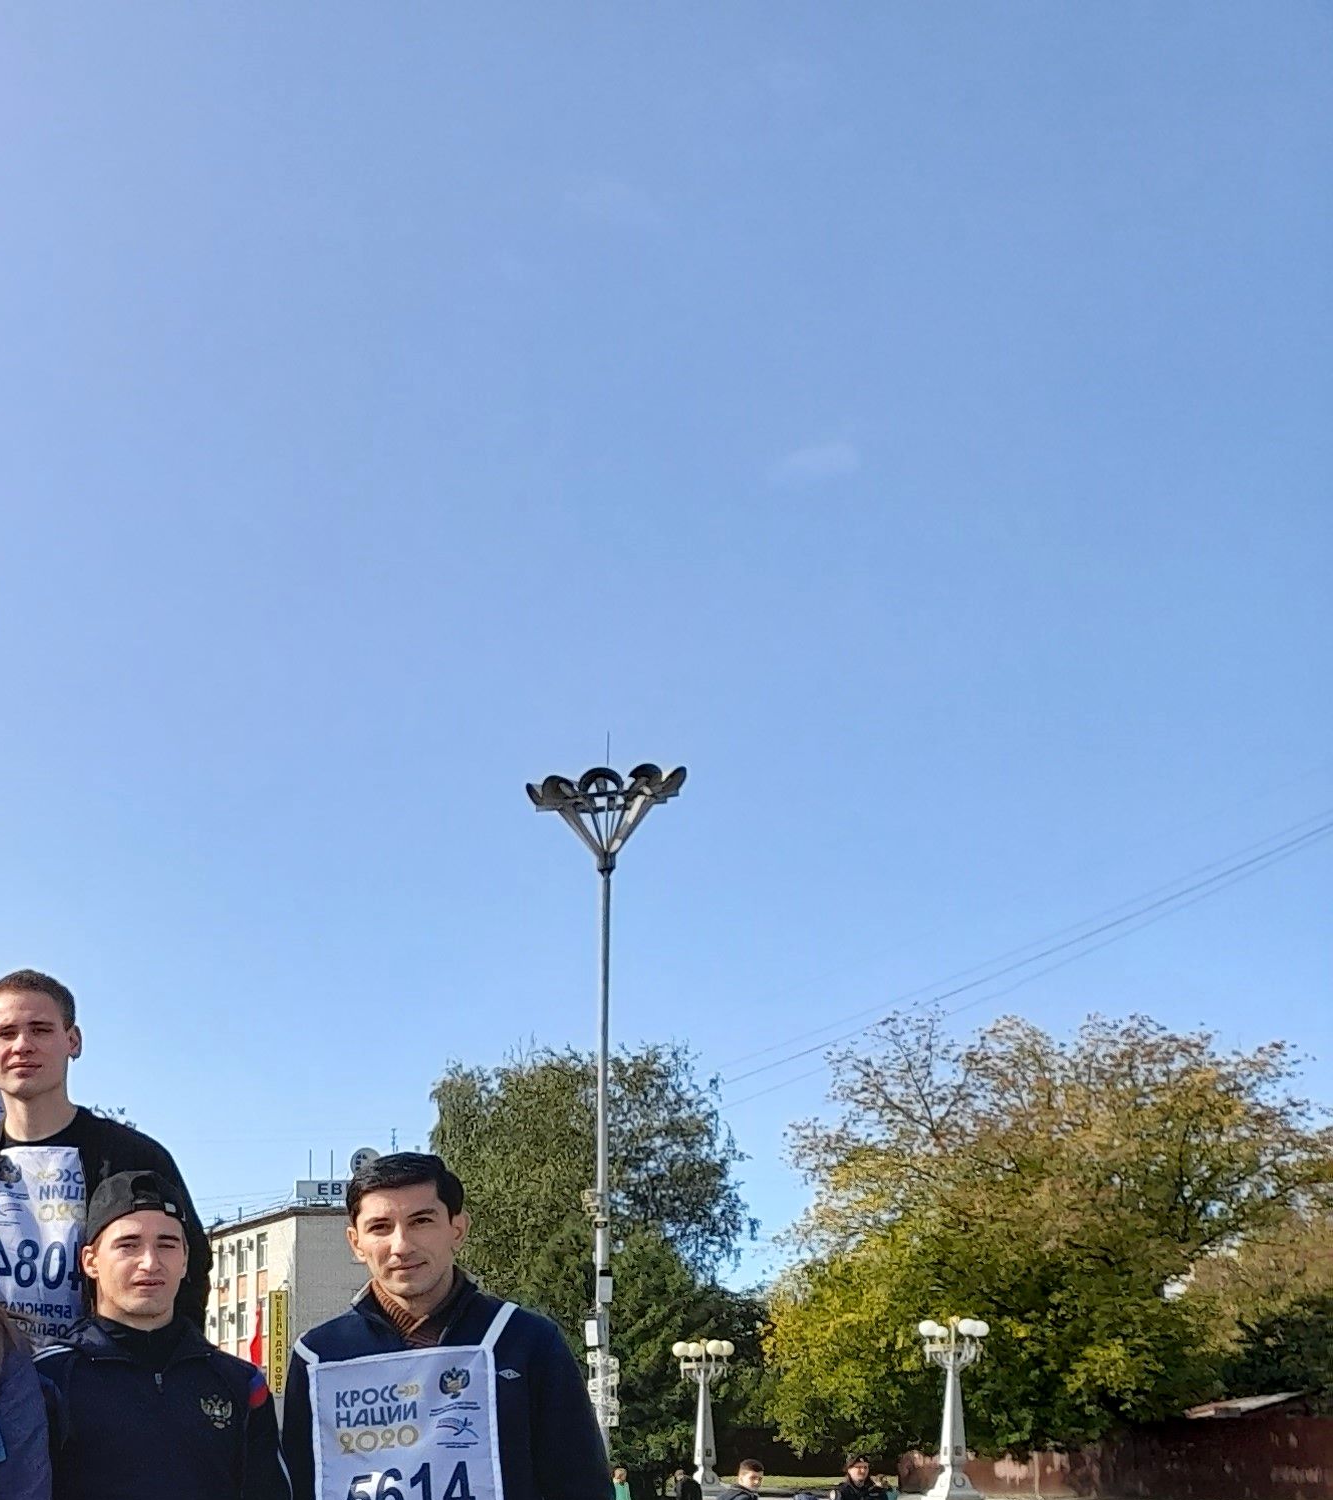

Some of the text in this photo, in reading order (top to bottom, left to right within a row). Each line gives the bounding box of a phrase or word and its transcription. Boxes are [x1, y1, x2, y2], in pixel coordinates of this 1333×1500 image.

[317, 1182, 349, 1195] ЕВ
[336, 1384, 398, 1408] КРОСС
[335, 1401, 418, 1428] НАЦИИ
[339, 1424, 419, 1454] 2020
